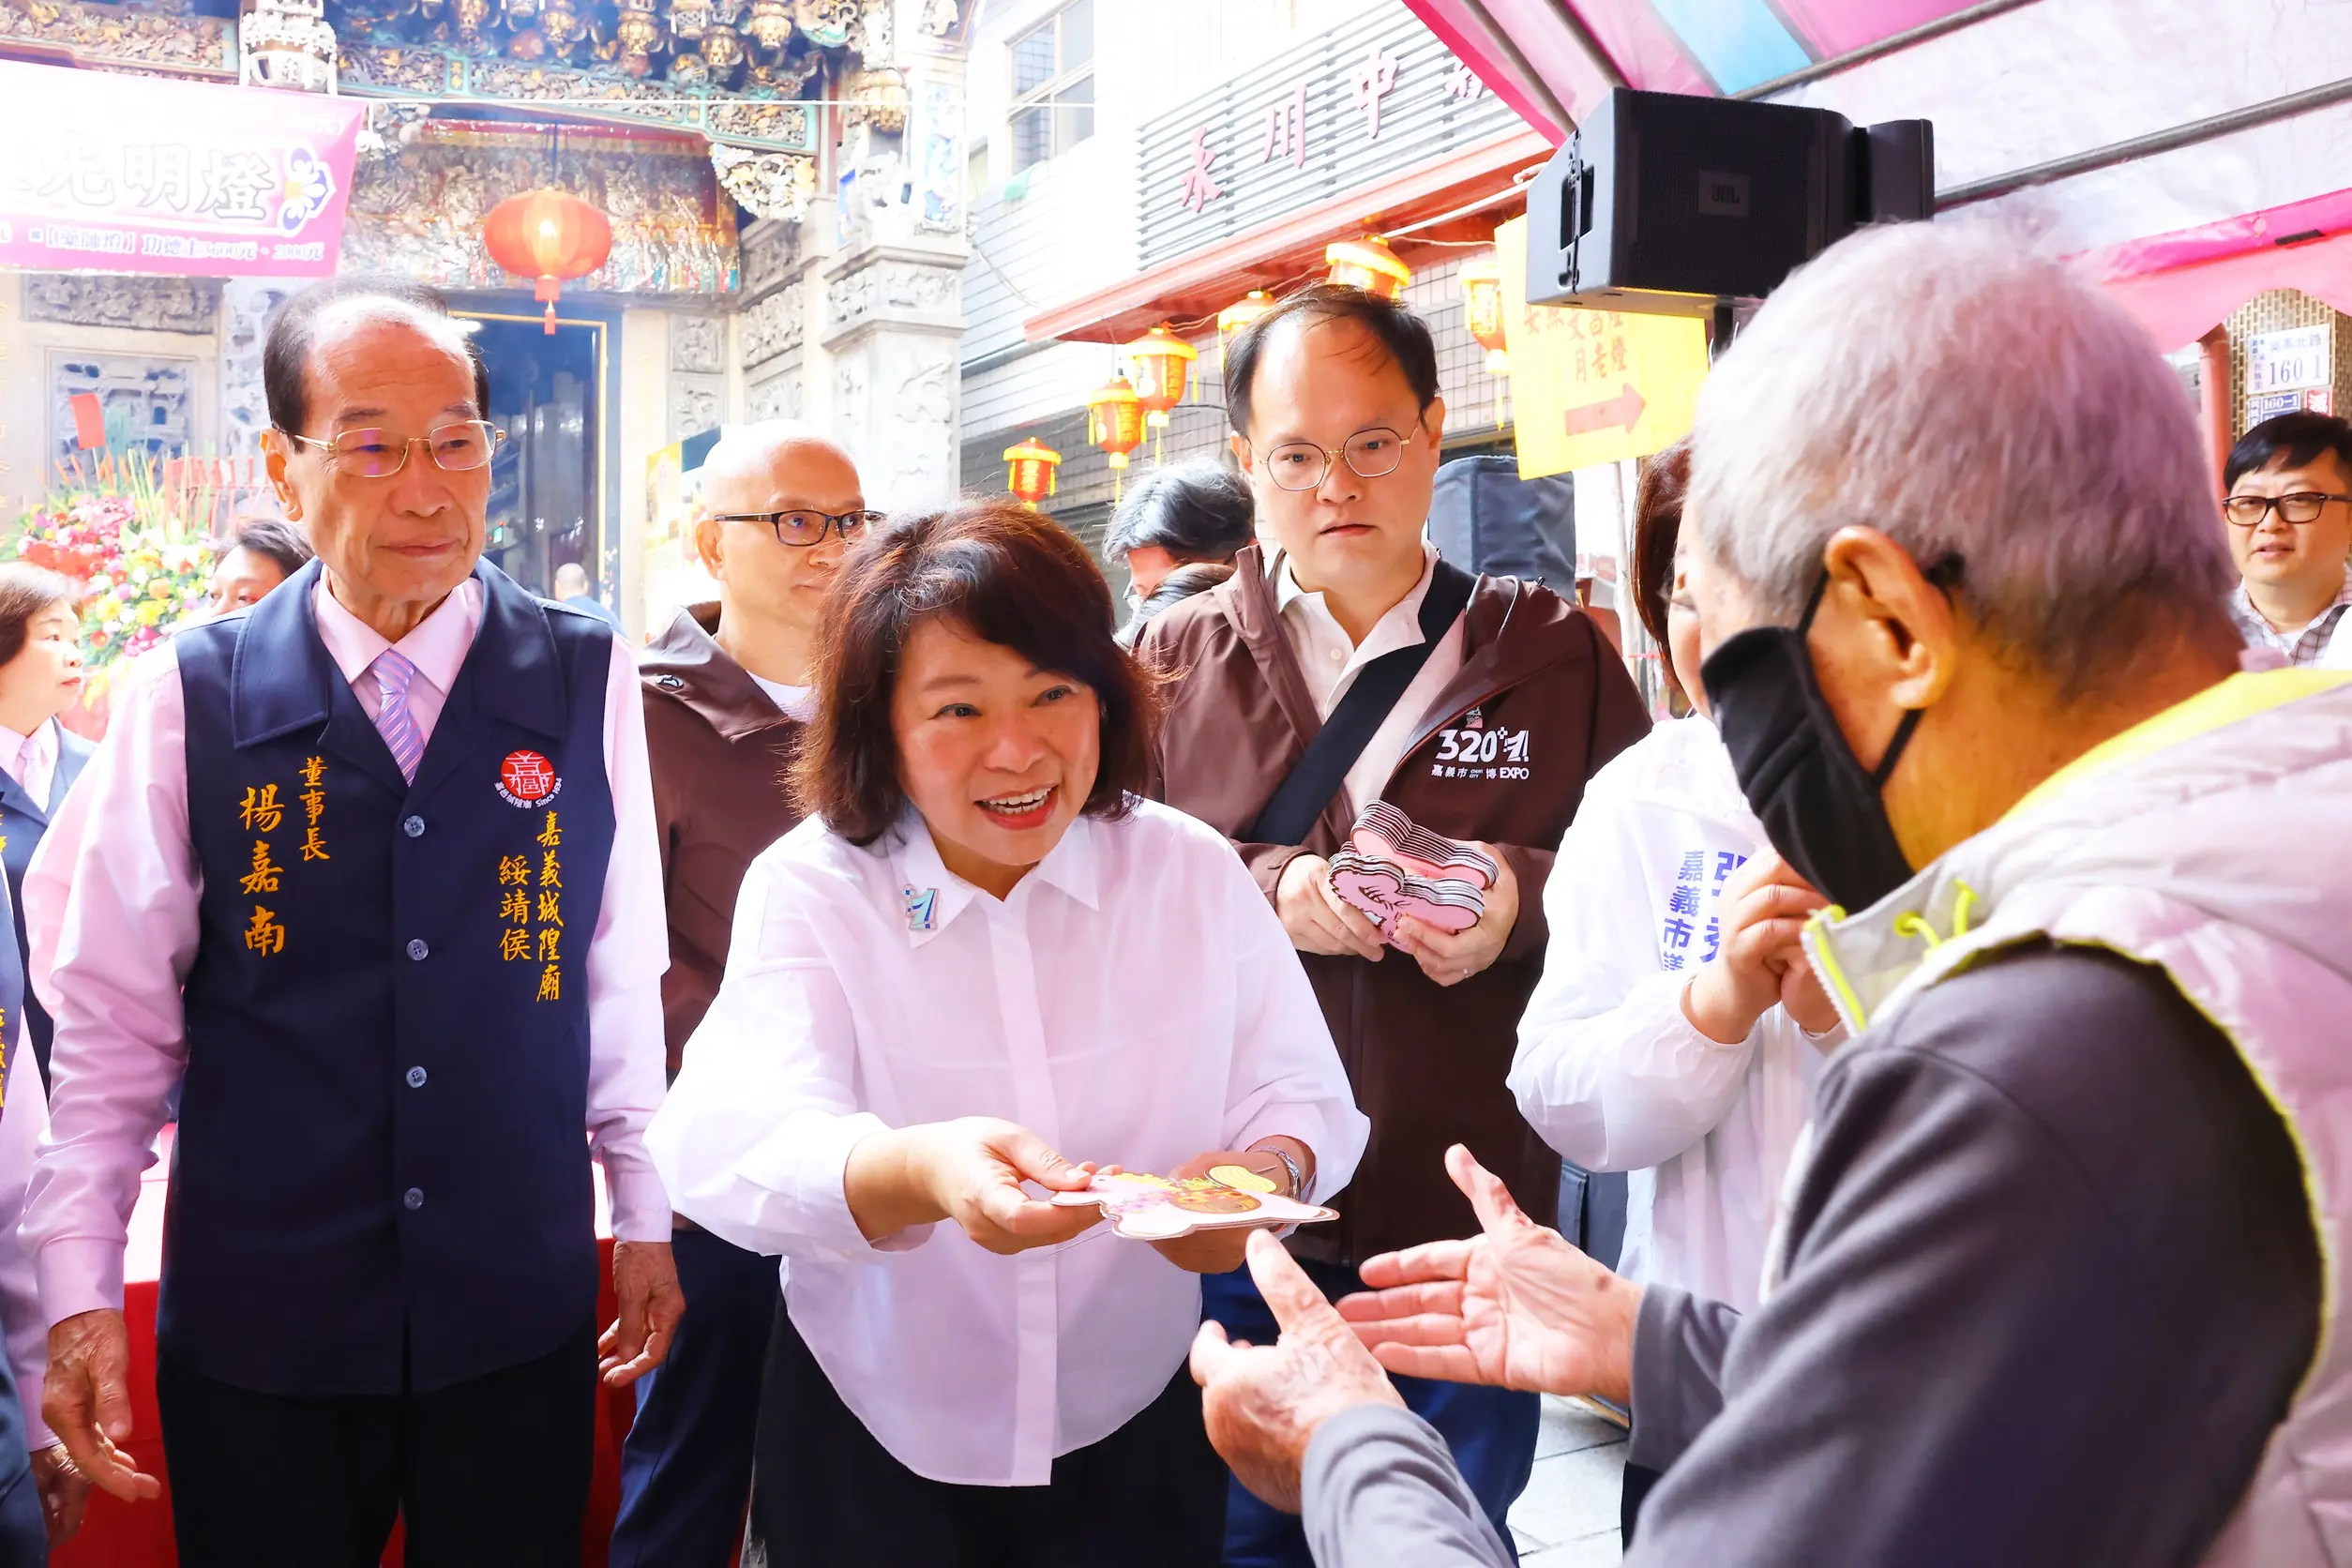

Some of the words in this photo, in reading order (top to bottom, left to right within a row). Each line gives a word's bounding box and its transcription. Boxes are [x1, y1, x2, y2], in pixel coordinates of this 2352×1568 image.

[8, 128, 275, 220] 光明燈
[1711, 183, 1741, 204] JBL
[2269, 356, 2303, 385] 160
[298, 756, 330, 862] 董事長
[535, 793, 555, 807] Since
[1431, 763, 1468, 779] 嘉義市
[1500, 766, 1530, 780] EXPO
[239, 783, 285, 957] 楊嘉南
[498, 854, 533, 961] 綏靖侯
[536, 810, 564, 1003] 嘉義城隍廟
